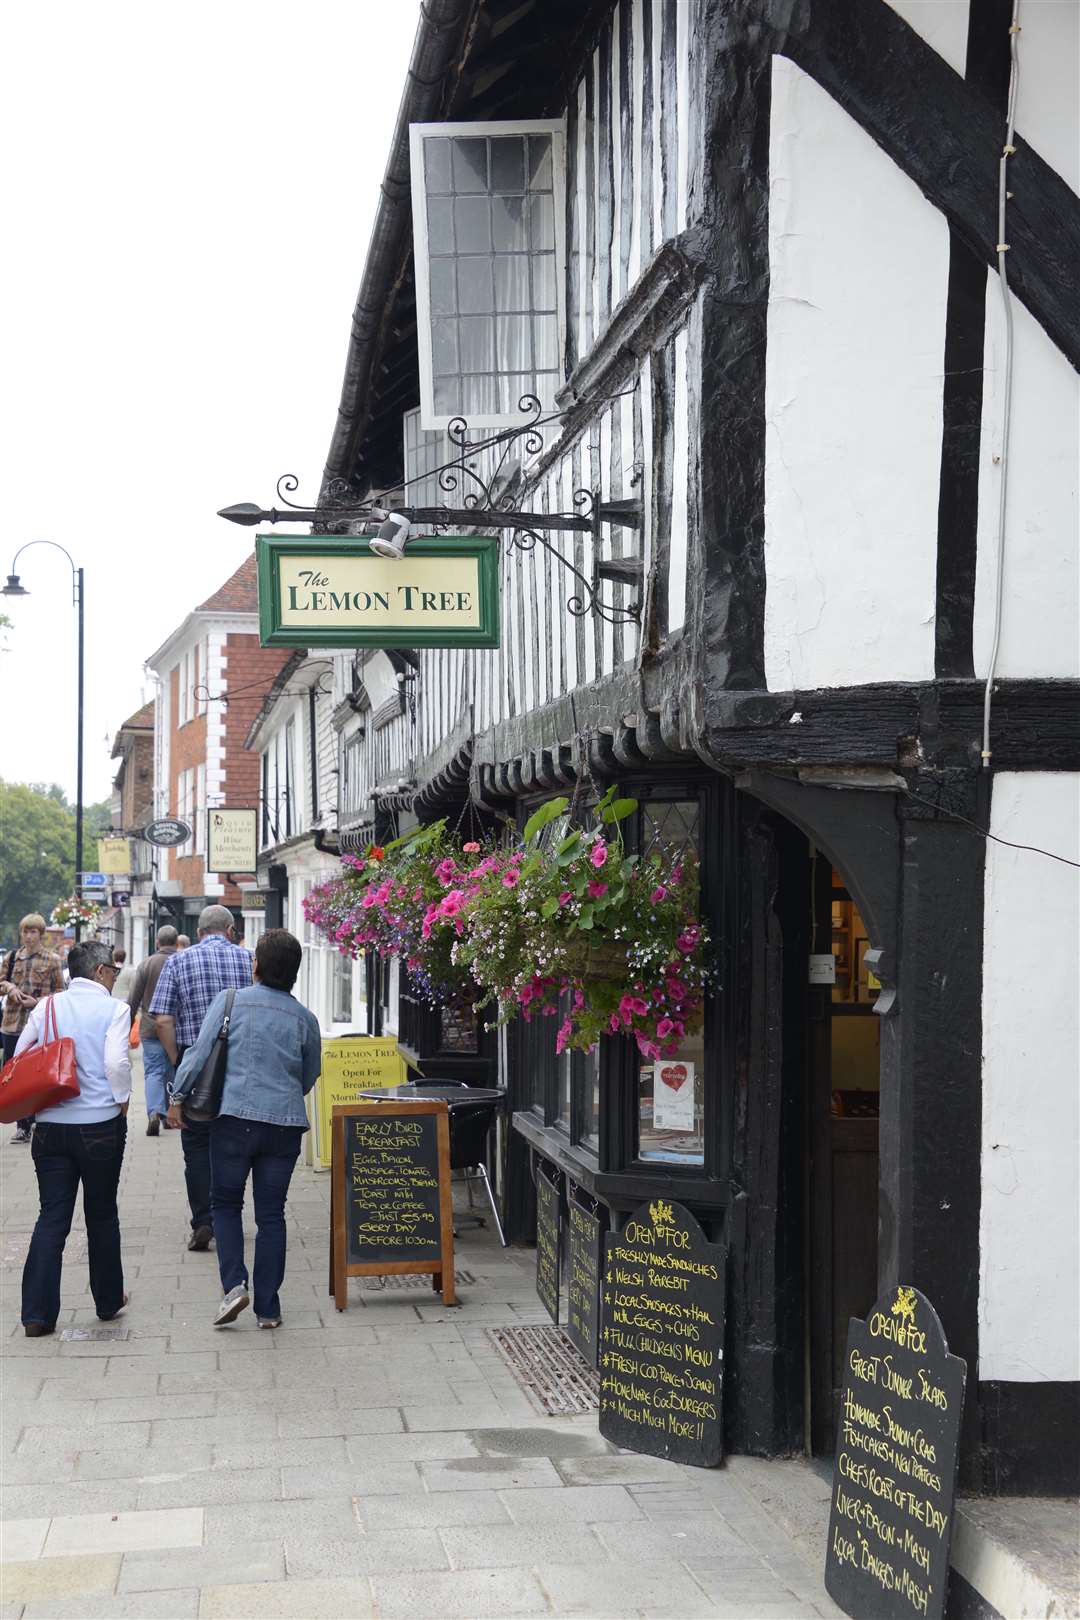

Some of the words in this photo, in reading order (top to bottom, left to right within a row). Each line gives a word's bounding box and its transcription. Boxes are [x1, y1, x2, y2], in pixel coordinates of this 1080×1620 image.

[298, 571, 330, 587] The
[288, 586, 390, 611] LEMON
[397, 586, 472, 611] TREE
[342, 1069, 364, 1078] Open
[367, 1068, 382, 1076] For
[356, 1122, 392, 1135] EARLY
[394, 1120, 423, 1134] BIRD
[360, 1135, 420, 1148] BREAKFAST
[354, 1188, 389, 1198] TOAST
[394, 1187, 414, 1199] WITH
[354, 1199, 378, 1208] TEA
[392, 1201, 426, 1210] COFFEE
[369, 1211, 399, 1221] JUST
[359, 1222, 391, 1232] EVERY
[393, 1224, 417, 1234] DAY
[626, 1222, 656, 1246] OPEN
[664, 1226, 692, 1250] FOR
[359, 1235, 402, 1245] BEFORE
[615, 1247, 649, 1266] FRESHLY
[666, 1253, 718, 1280] SANDWICHES
[616, 1268, 644, 1287] WELSH
[648, 1268, 690, 1291] RAREBIT
[614, 1290, 642, 1308] LOCAL
[674, 1320, 700, 1341] CHIPS
[870, 1312, 898, 1342] OPEN
[907, 1326, 928, 1354] FOR
[609, 1351, 638, 1376] FRESH
[686, 1344, 712, 1367] MENU
[850, 1349, 881, 1384] GREAT
[882, 1355, 912, 1400] SUMMER
[916, 1368, 948, 1410] SALADS
[610, 1375, 652, 1405] HOMEMADE
[668, 1390, 716, 1420] BURGERS
[914, 1428, 936, 1464] CRAB
[895, 1452, 910, 1476] NEW
[911, 1456, 941, 1492] POTATOES
[868, 1468, 896, 1502] ROAST
[894, 1490, 907, 1510] OF
[907, 1492, 924, 1522] THE
[925, 1500, 948, 1539] DAY
[836, 1484, 862, 1525] LIVER
[864, 1502, 896, 1545] BACON
[904, 1529, 930, 1576] MASH
[833, 1526, 858, 1568] LOCAL
